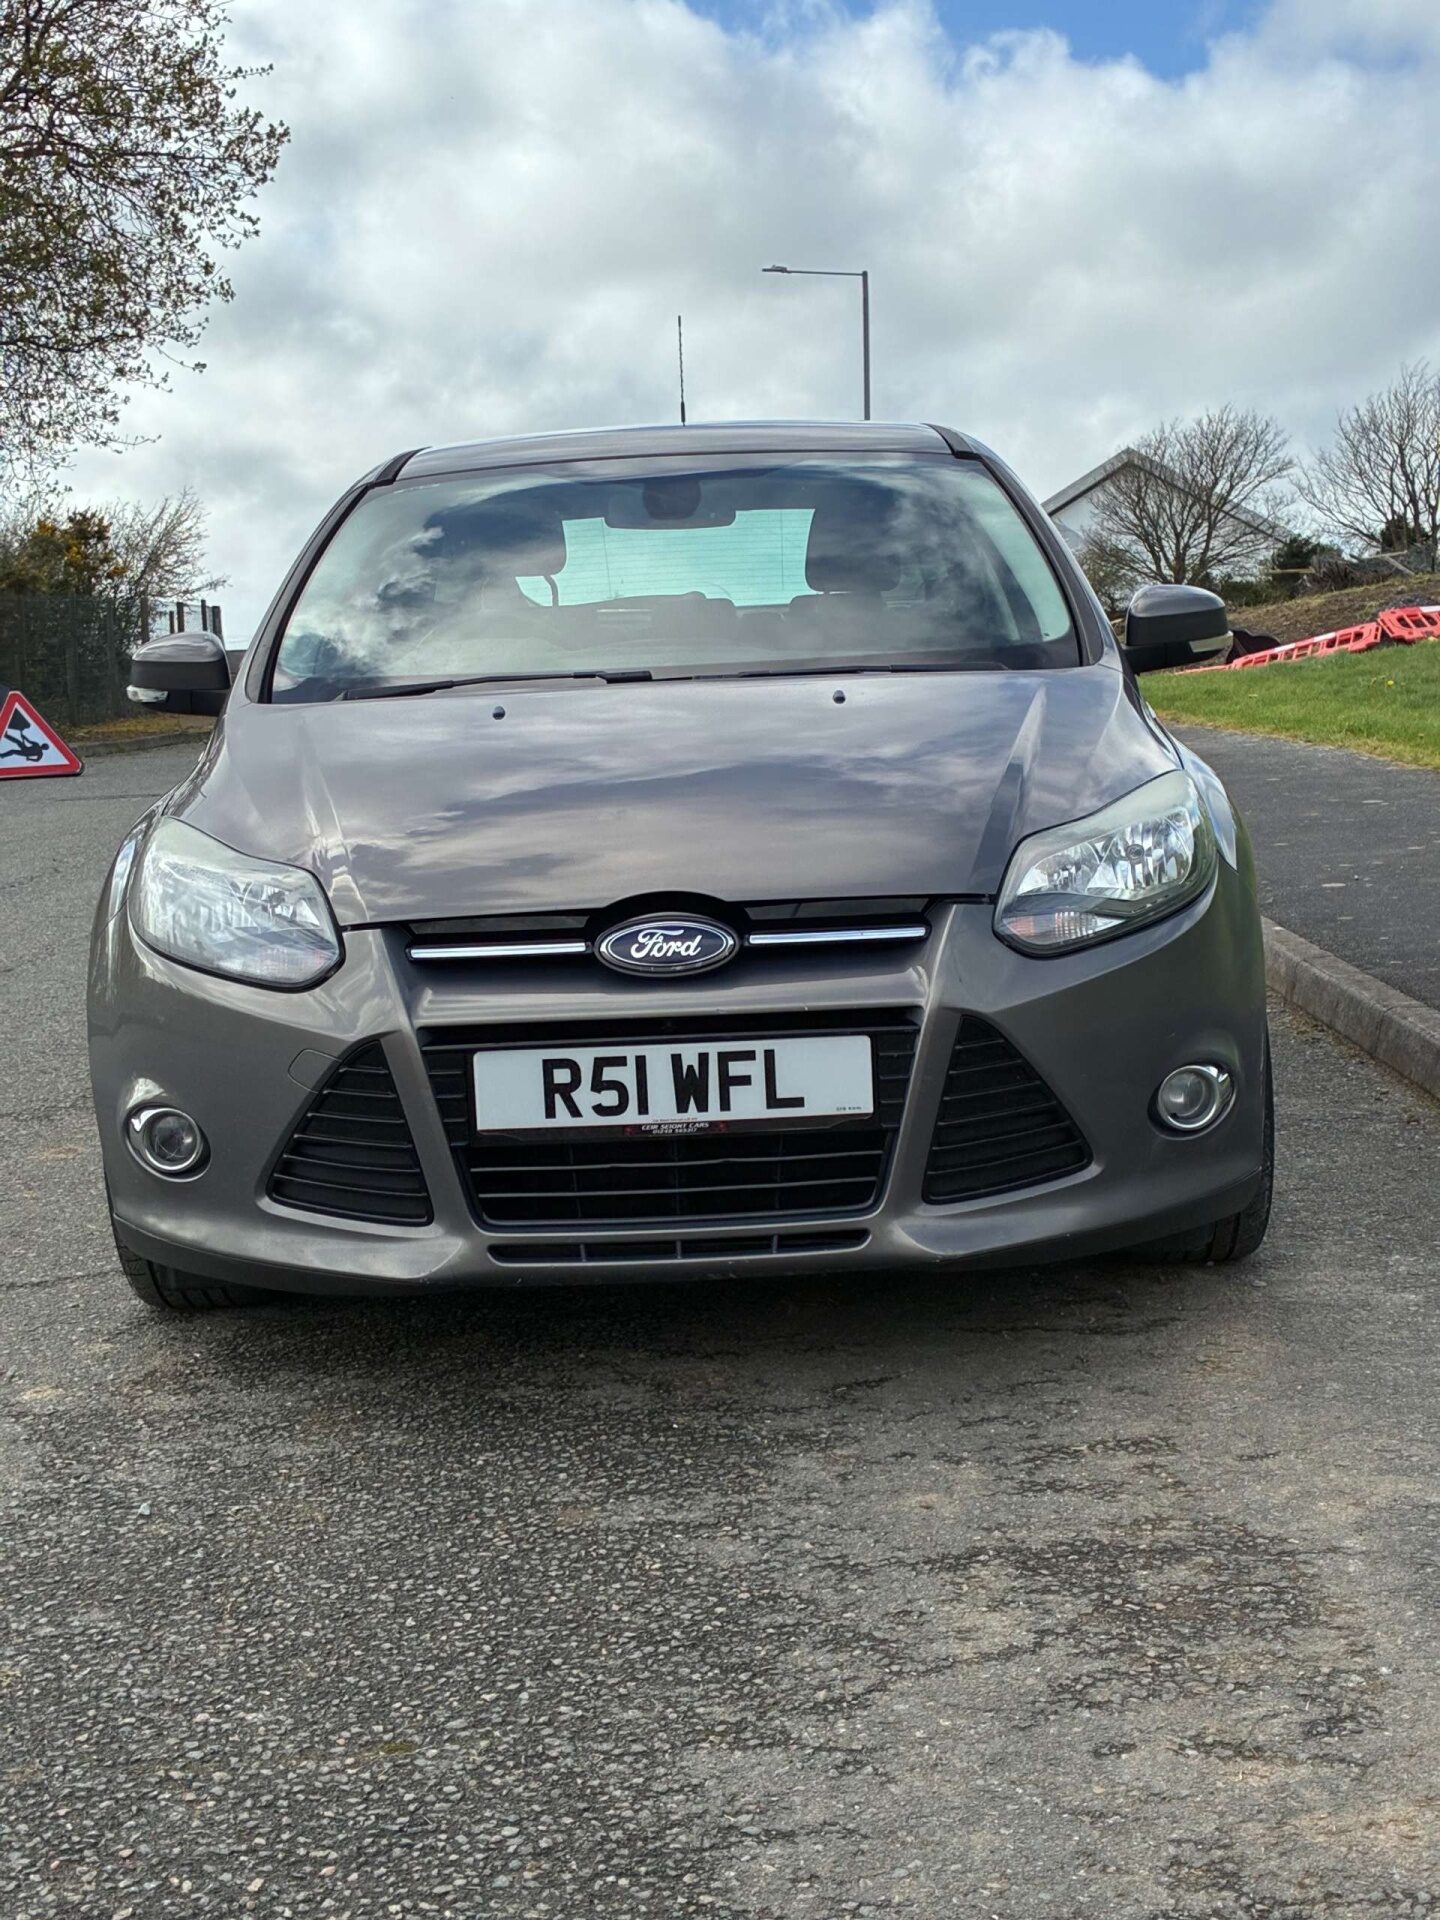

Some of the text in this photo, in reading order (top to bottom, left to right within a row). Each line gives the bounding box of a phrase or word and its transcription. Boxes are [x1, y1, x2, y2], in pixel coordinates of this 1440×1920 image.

[630, 929, 703, 959] Ford
[542, 1049, 805, 1119] R51 WFL
